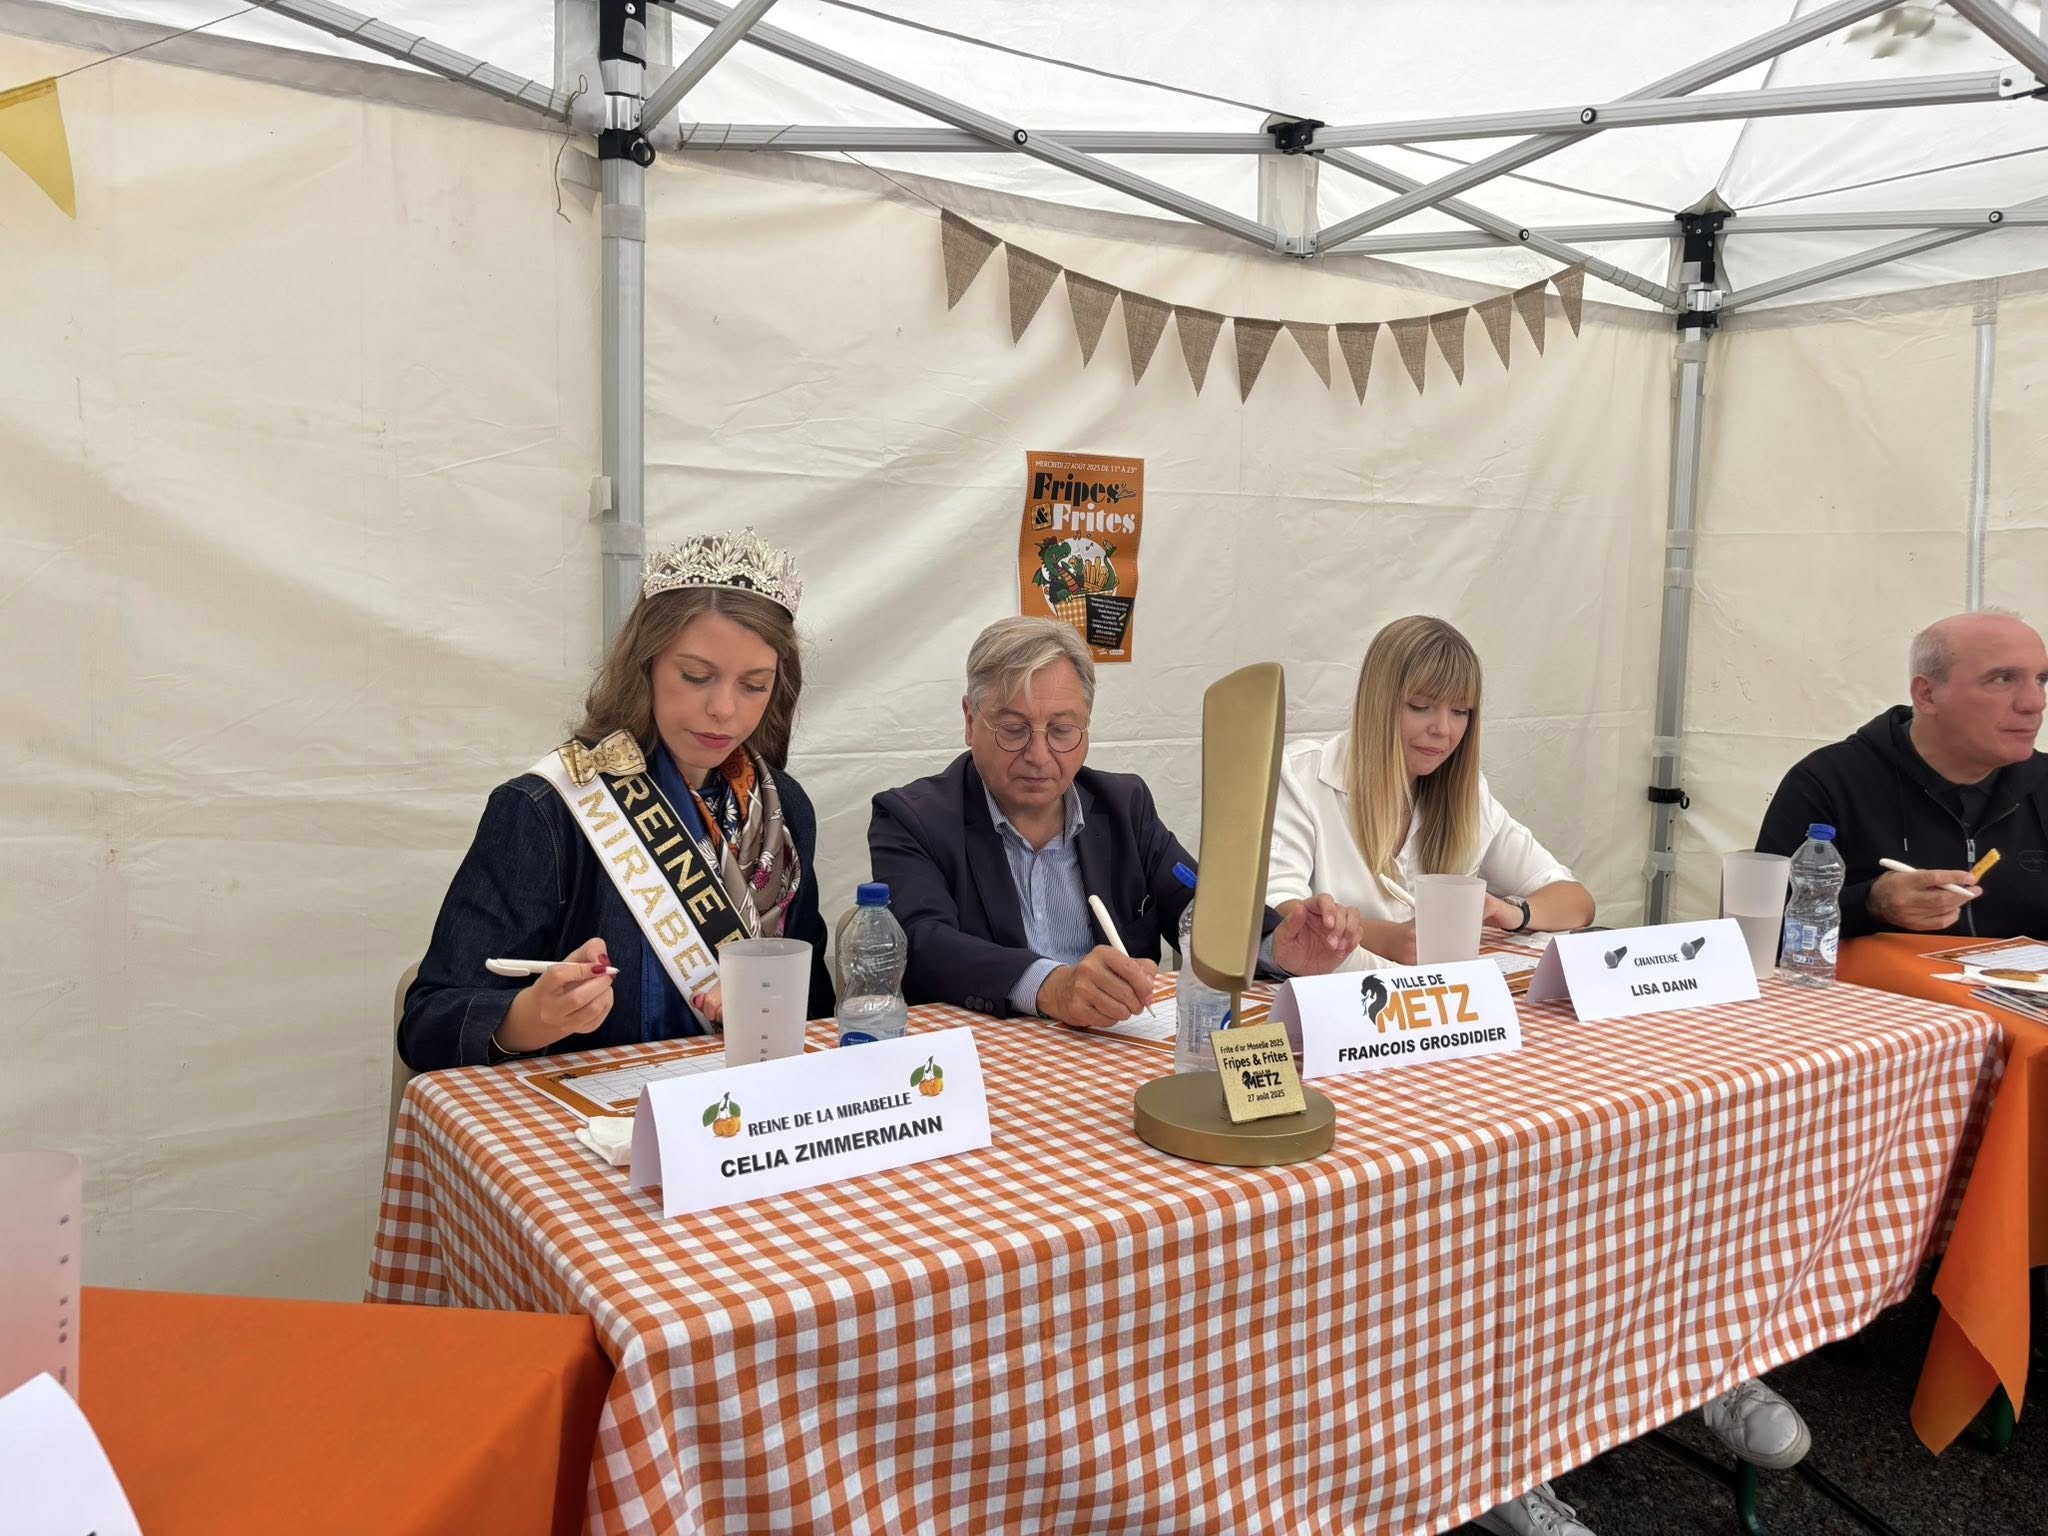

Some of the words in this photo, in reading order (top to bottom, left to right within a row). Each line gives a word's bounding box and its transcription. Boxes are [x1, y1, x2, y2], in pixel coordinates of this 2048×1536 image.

[1035, 460, 1063, 469] MERCREDI
[1033, 472, 1120, 506] Fripes
[1035, 507, 1048, 524] &
[1052, 503, 1136, 533] Frites
[611, 775, 727, 925] REINE
[1634, 953, 1680, 967] CHANTEUSE
[1391, 975, 1426, 990] VILLE
[1429, 974, 1446, 986] DE
[1630, 982, 1661, 997] LISA
[1662, 978, 1698, 993] DANN
[1377, 984, 1479, 1034] METZ
[1220, 1046, 1234, 1054] Frite
[1246, 1041, 1269, 1050] Moselle
[1269, 1038, 1285, 1048] 2025
[1338, 1039, 1416, 1062] FRANCOIS
[1420, 1027, 1507, 1051] GROSDIDIER
[1223, 1056, 1251, 1072] Fripes
[1252, 1053, 1262, 1066] &
[1262, 1051, 1289, 1064] Frites
[1248, 1071, 1282, 1089] METZ
[1247, 1093, 1255, 1102] 27
[1256, 1092, 1270, 1101] août
[1270, 1089, 1285, 1099] 2025
[748, 1117, 791, 1137] REINE
[794, 1113, 813, 1129] DE
[817, 1109, 834, 1122] LA
[837, 1092, 912, 1119] MIRABELLE
[721, 1148, 789, 1179] CELIA
[795, 1115, 944, 1163] ZIMMERMANN
